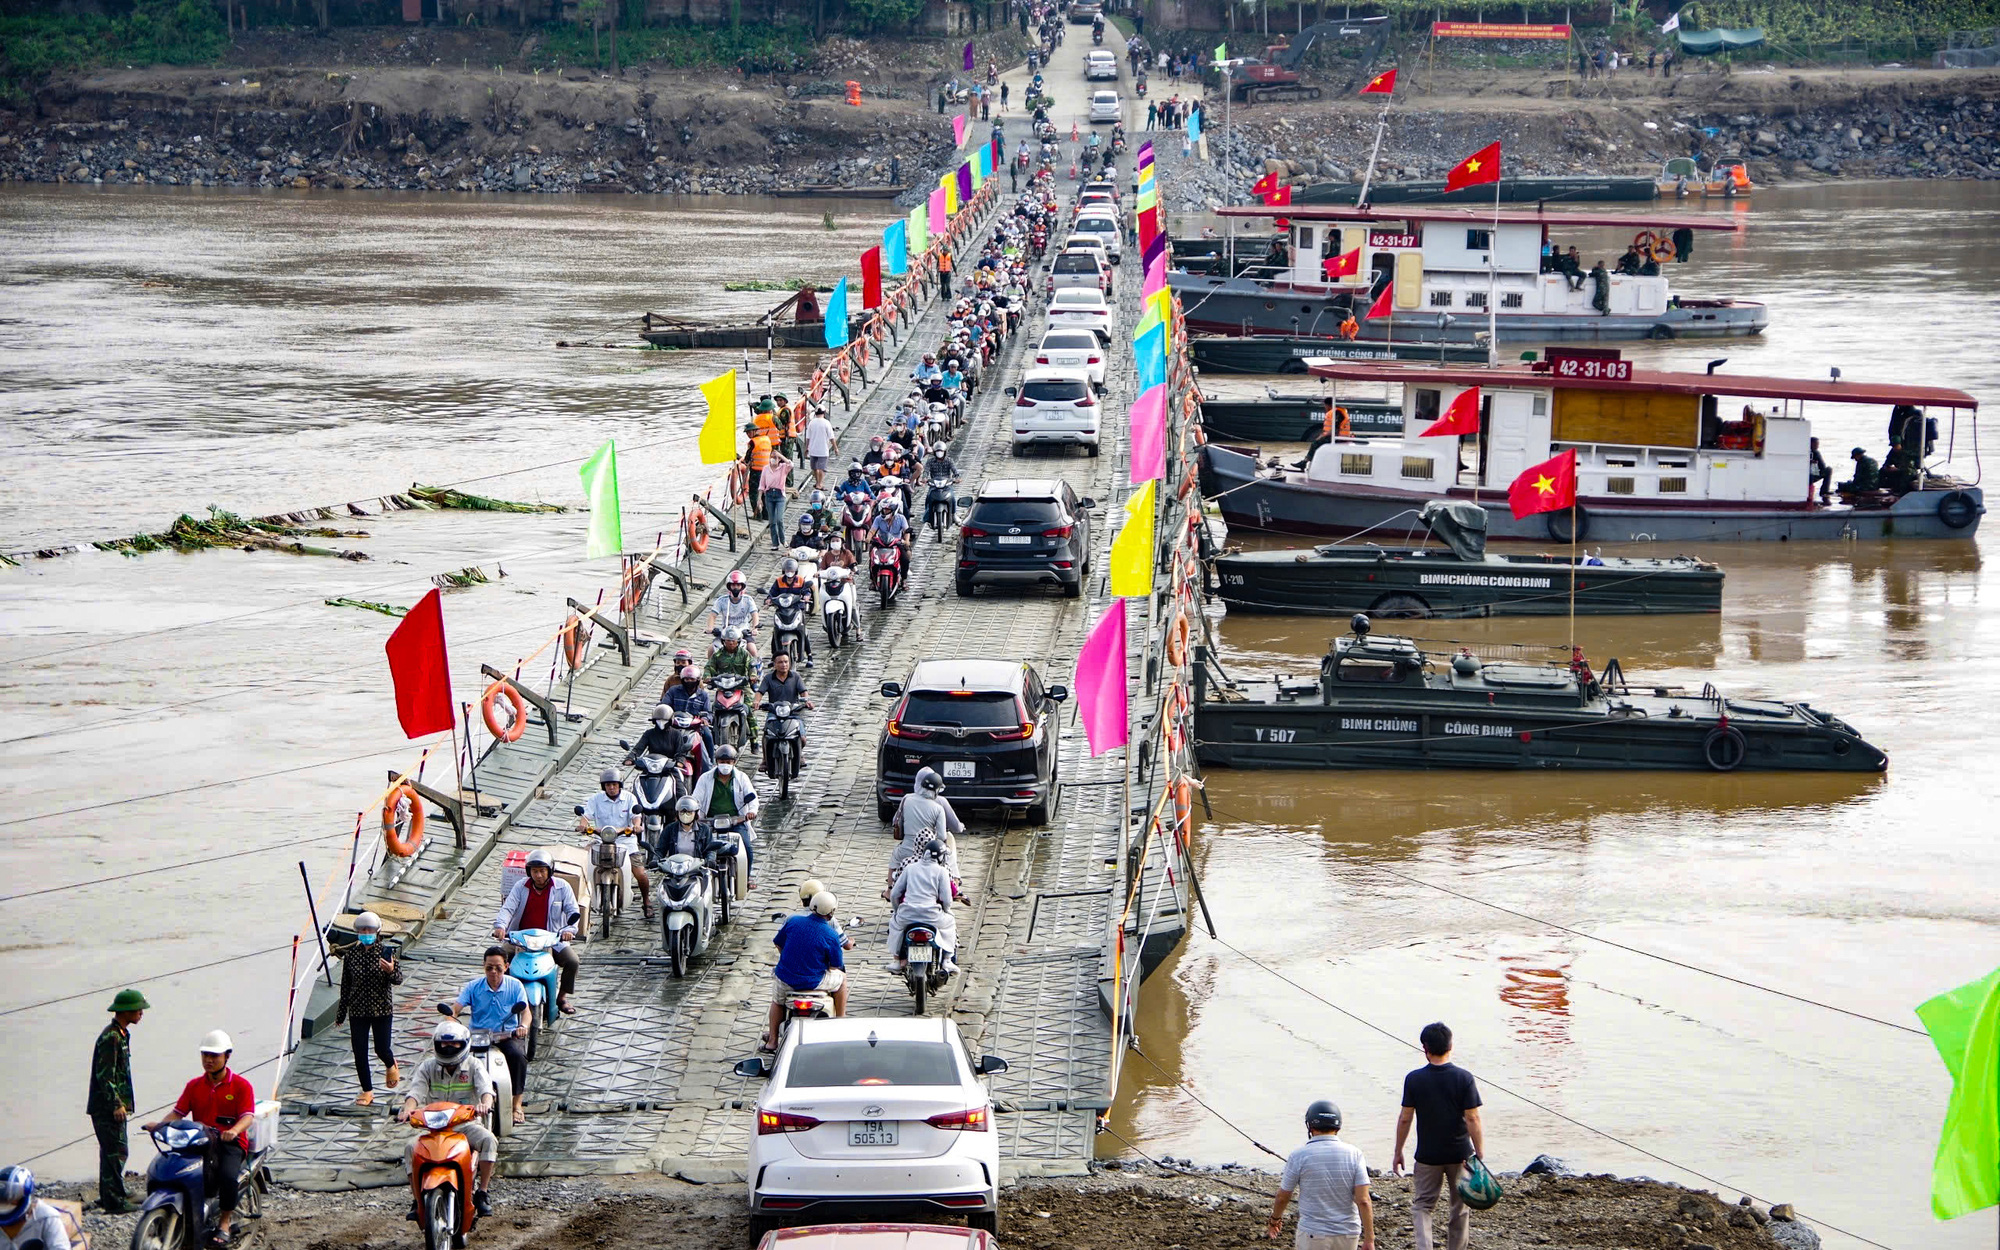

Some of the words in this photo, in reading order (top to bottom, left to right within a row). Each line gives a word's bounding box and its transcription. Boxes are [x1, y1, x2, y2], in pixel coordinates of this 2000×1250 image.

[1372, 235, 1415, 247] 42-31-07
[1292, 348, 1315, 357] BINH
[1559, 359, 1627, 379] 42-31-03
[1223, 574, 1244, 585] Y-210
[1341, 718, 1371, 730] BINH
[1444, 721, 1479, 735] CÔNG
[1482, 725, 1513, 737] BINH
[1255, 728, 1264, 742] Y
[1269, 729, 1296, 743] 507
[953, 762, 967, 770] 19A
[947, 769, 972, 777] 460.35
[864, 1121, 884, 1132] 19A
[854, 1133, 893, 1144] 505.13
